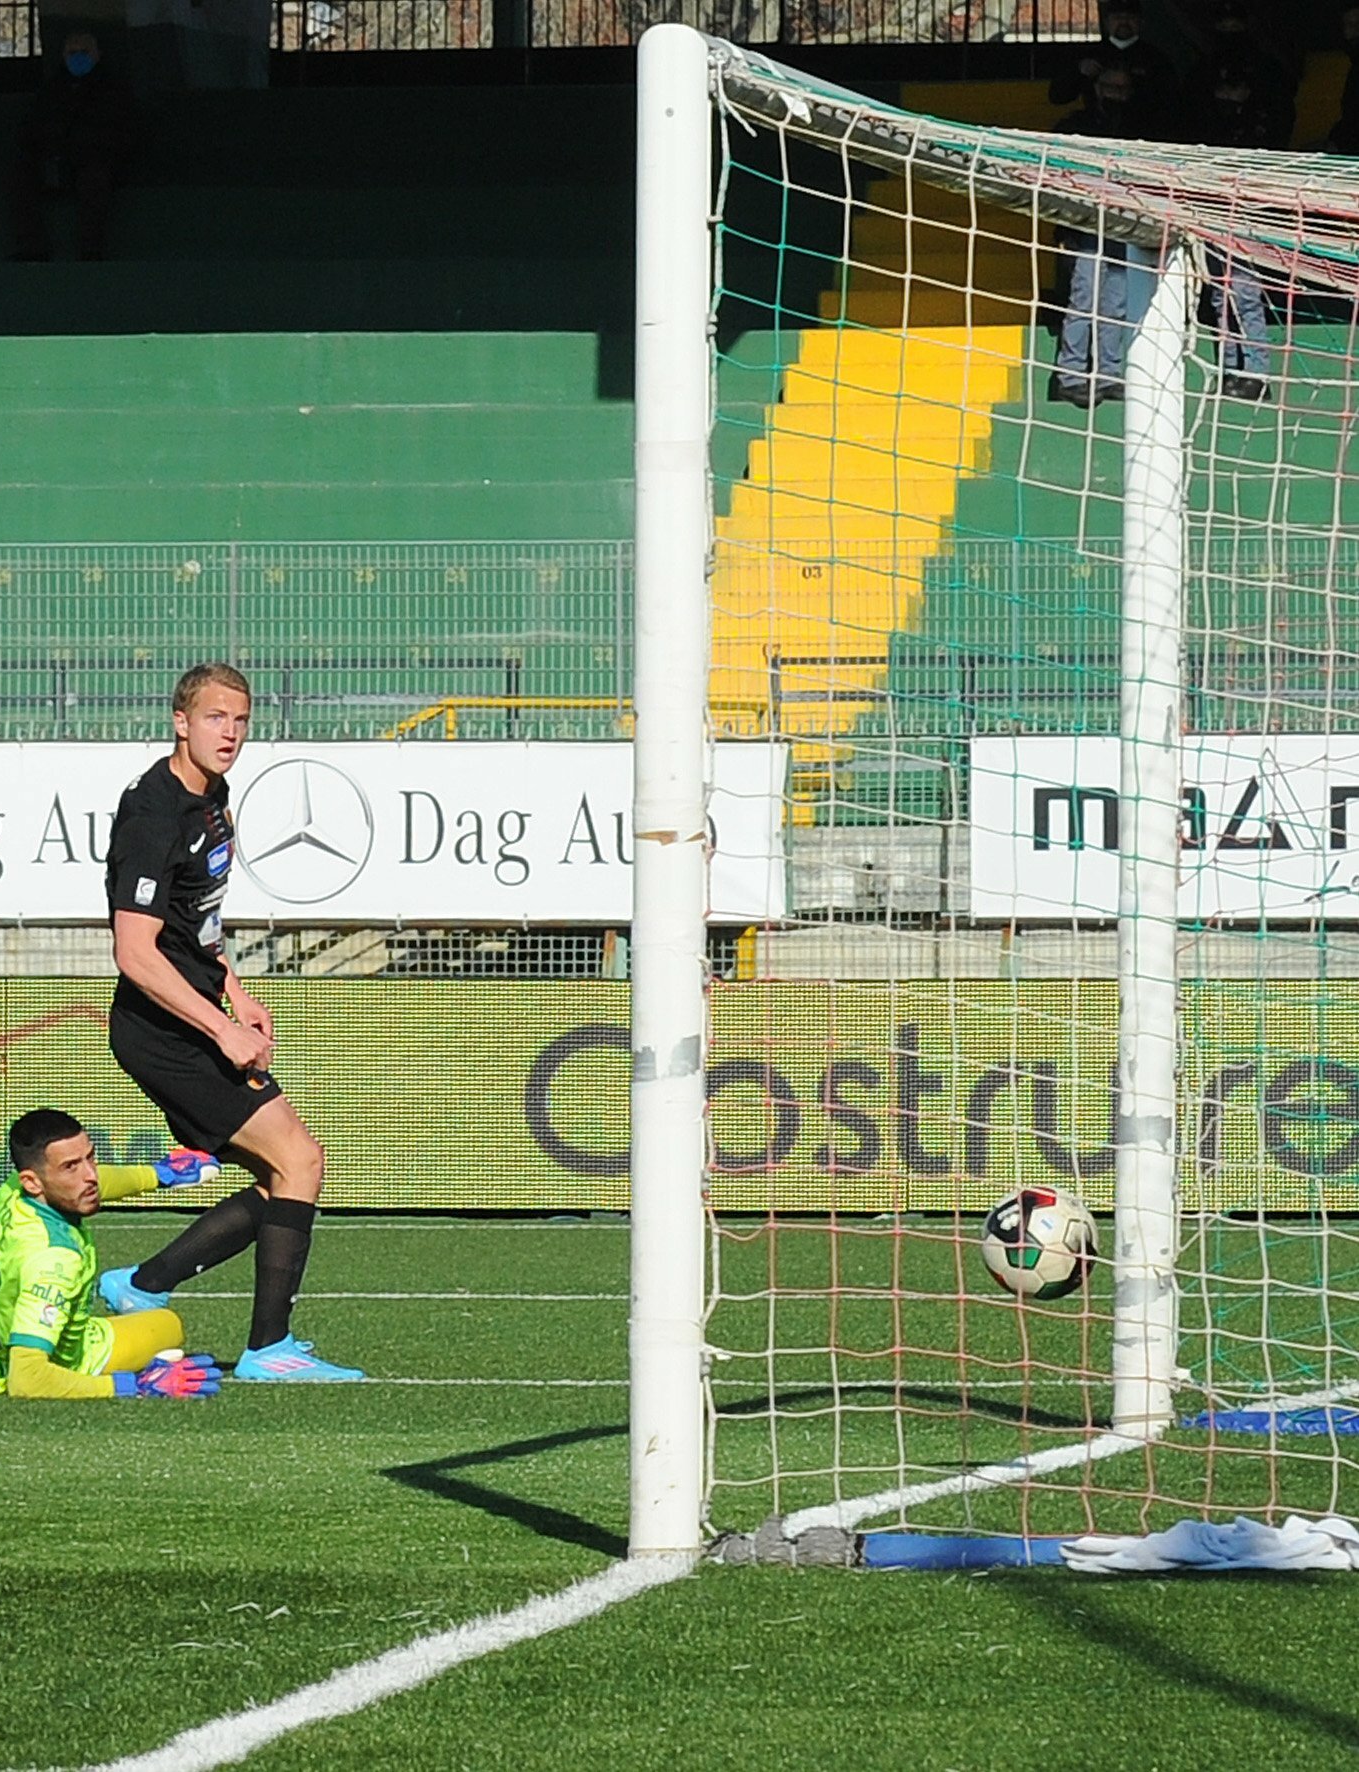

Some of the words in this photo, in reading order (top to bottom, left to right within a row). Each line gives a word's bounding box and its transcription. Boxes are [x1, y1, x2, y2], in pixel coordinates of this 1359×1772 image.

[801, 565, 822, 580] 03
[31, 791, 112, 865] Au
[399, 789, 533, 887] Dag
[525, 1022, 1359, 1178] Costrure
